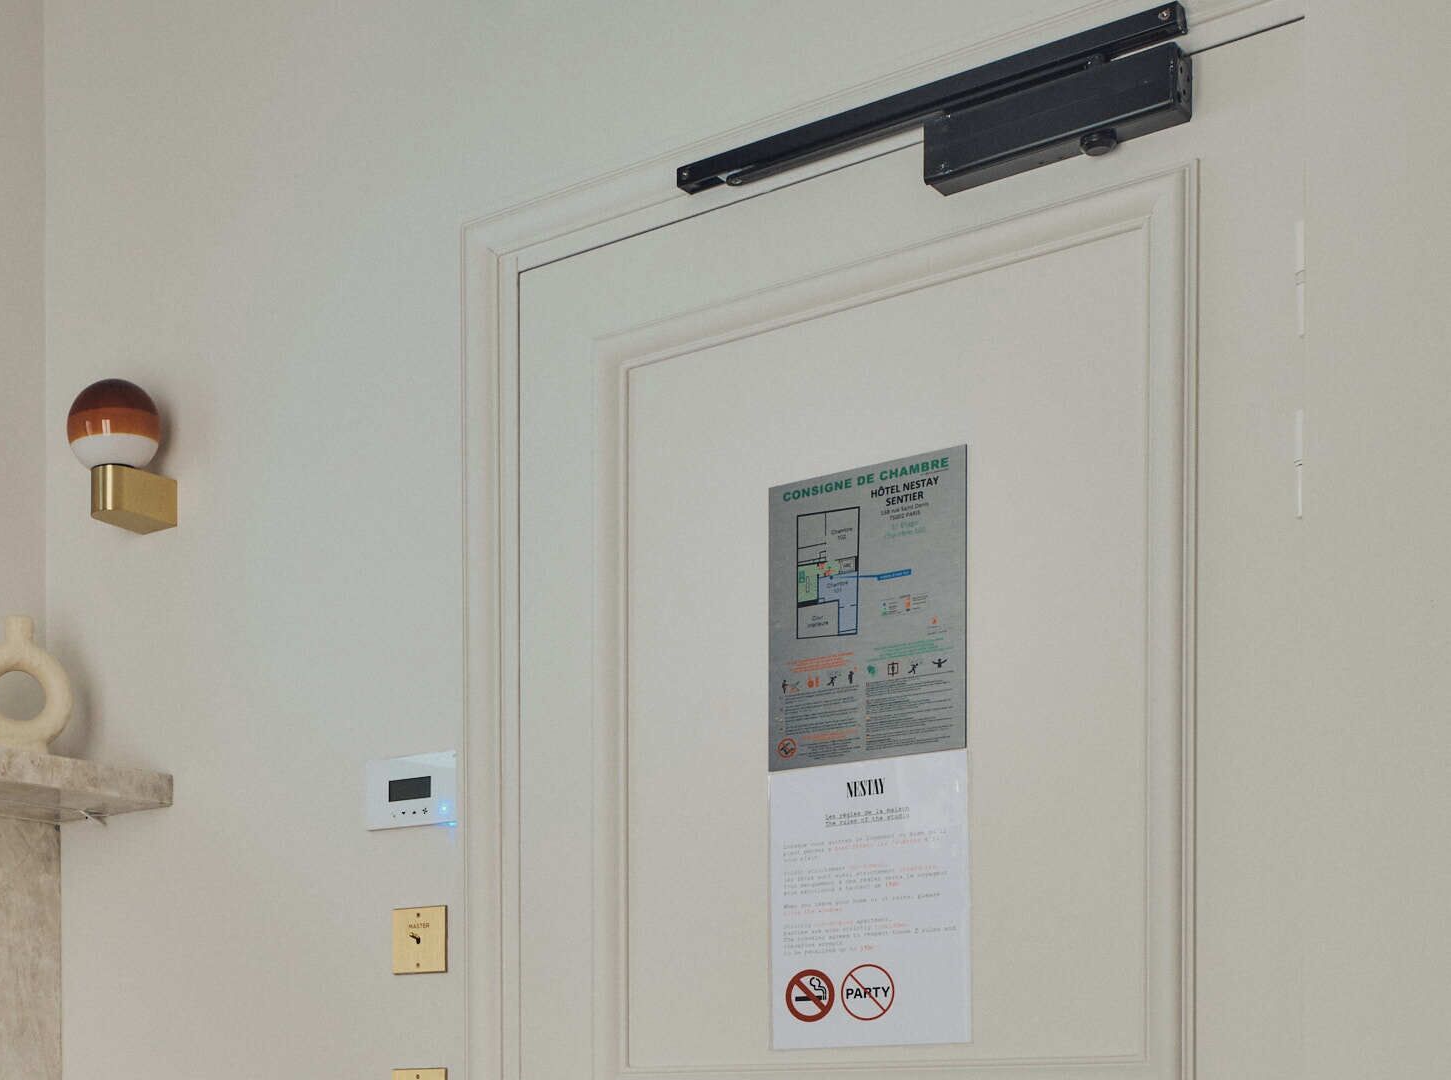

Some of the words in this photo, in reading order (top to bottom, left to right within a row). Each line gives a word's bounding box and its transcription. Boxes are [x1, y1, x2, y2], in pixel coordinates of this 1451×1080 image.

[783, 479, 852, 502] CONSIGNE
[857, 473, 874, 486] DE
[879, 457, 950, 481] CHAMBRE
[870, 485, 901, 499] HÔTEL
[902, 476, 940, 491] NESTAY
[885, 491, 924, 506] SENTIER
[846, 778, 886, 799] NESTAY
[845, 986, 890, 1000] PARTY
